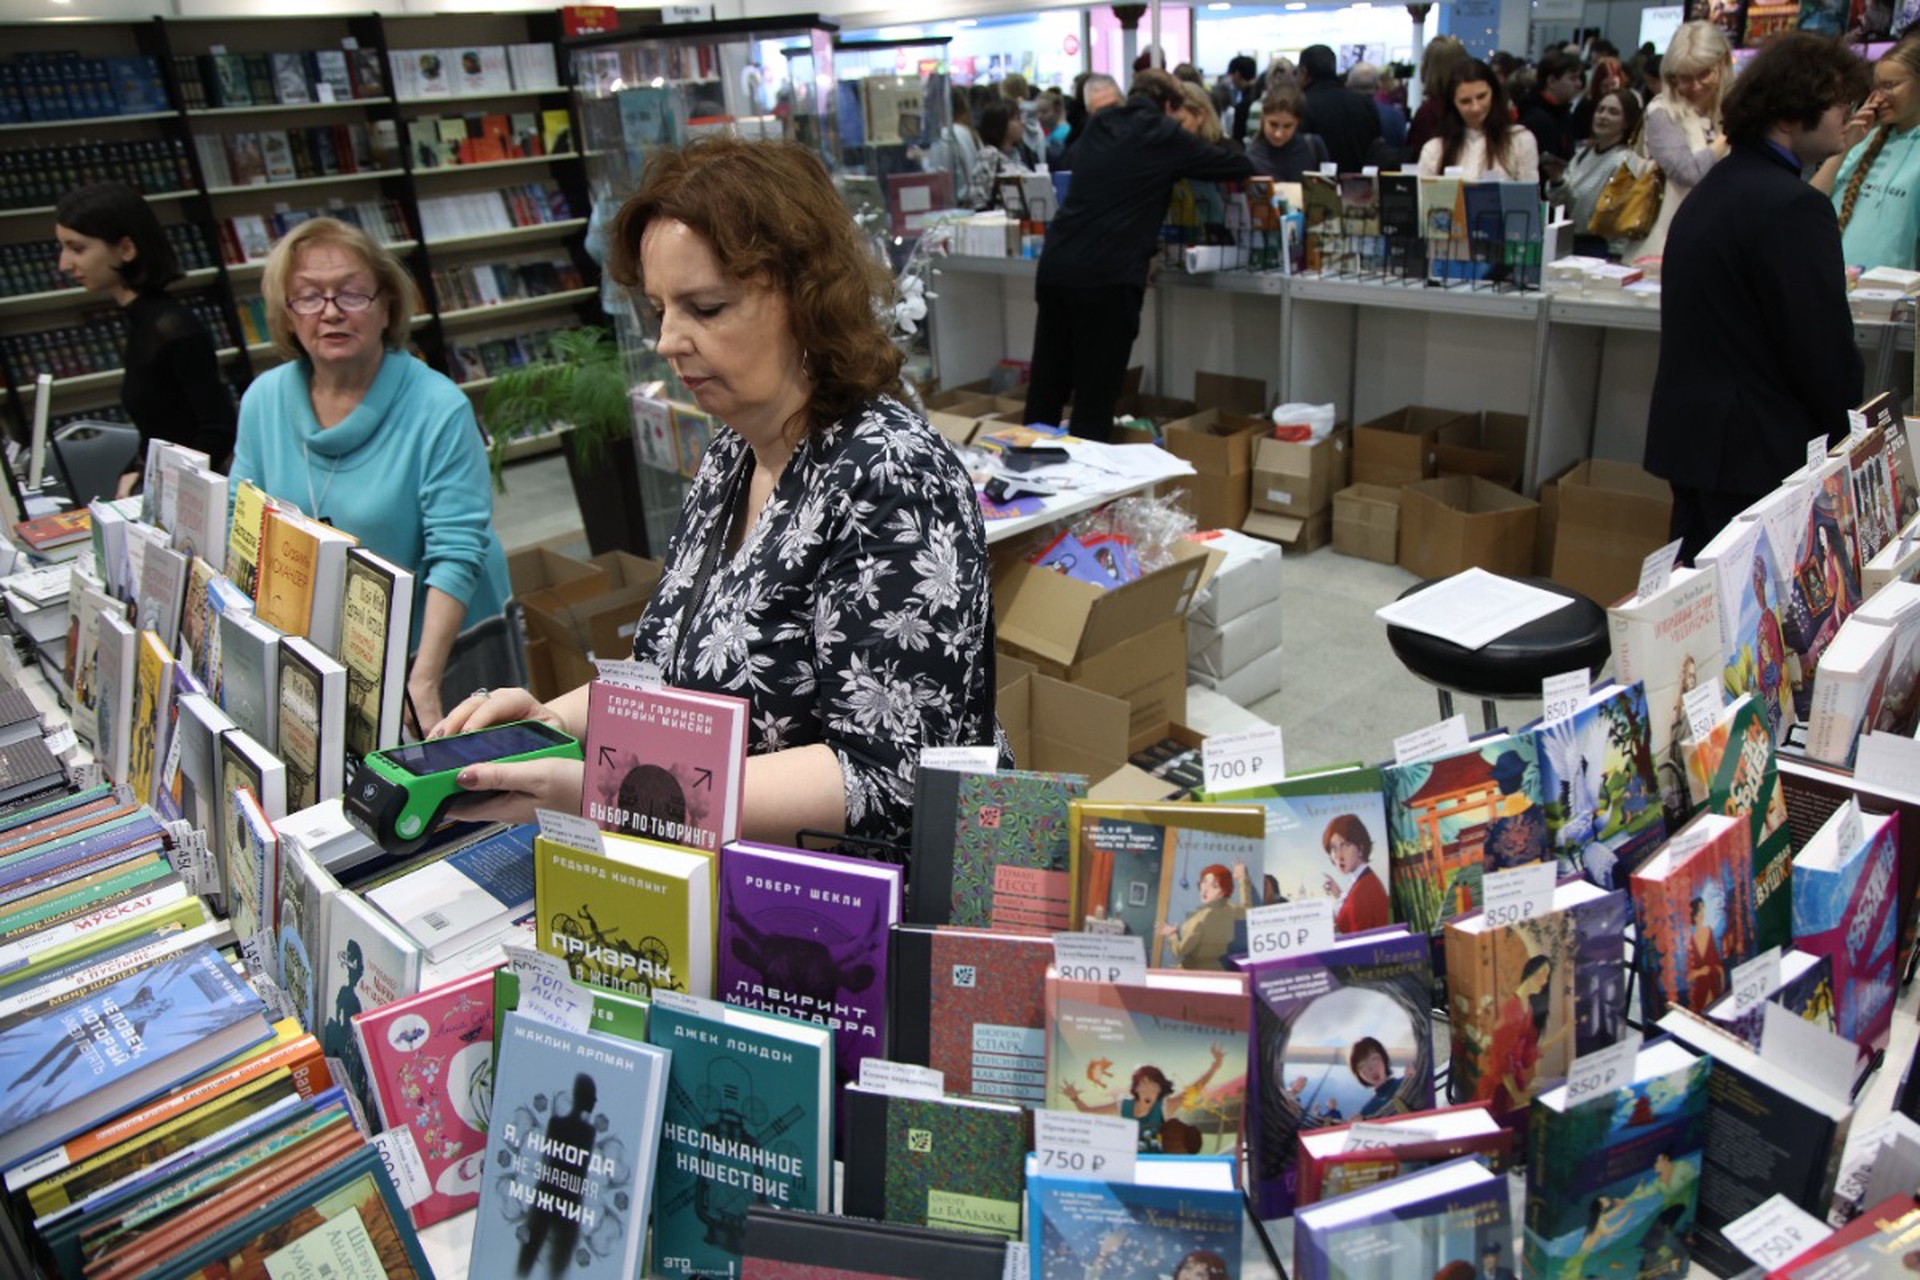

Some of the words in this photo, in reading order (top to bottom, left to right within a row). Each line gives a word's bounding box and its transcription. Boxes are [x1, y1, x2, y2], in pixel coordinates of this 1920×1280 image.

[607, 706, 656, 722] МАРВИН
[661, 716, 713, 735] МИНСКИ
[608, 695, 644, 710] ГАРРИ
[650, 704, 713, 724] ГАРРИСОН
[1208, 759, 1246, 781] 700
[590, 802, 630, 828] ВЫБОР
[632, 812, 648, 832] ПО
[651, 817, 716, 849] ТЬЮРИНГУ
[552, 855, 607, 881] РЕДЬЯРД
[612, 872, 668, 895] КИПЛИНГ
[745, 875, 803, 896] РОБЕРТ
[810, 888, 862, 908] ШЕКЛИ
[998, 879, 1038, 893] ГЕССЕ
[1486, 905, 1519, 927] 850
[551, 932, 672, 984] ПРИЗРАК
[1253, 930, 1291, 953] 650
[575, 965, 584, 980] В
[1061, 965, 1101, 981] 800
[726, 993, 877, 1038] МИНОТАВРА
[736, 980, 868, 1020] ЛАБИРИНТ
[78, 1005, 130, 1067] КОТОРЫЙ
[514, 1027, 572, 1052] ЖАКЛИН
[576, 1046, 635, 1071] АРПМАН
[674, 1025, 718, 1046] ДЖЕК
[727, 1038, 793, 1063] ЛОНДОН
[975, 1039, 1023, 1053] СПАРК
[1568, 1074, 1599, 1100] 850
[503, 1122, 520, 1147] Я,
[527, 1132, 616, 1178] НИКОГДА
[663, 1122, 803, 1178] НЕСЛЫХАННОЕ
[1042, 1149, 1085, 1171] 750
[510, 1157, 530, 1176] НЕ
[533, 1158, 600, 1200] ЗНАВШАЯ
[676, 1152, 790, 1202] НАШЕСТВИЕ
[508, 1181, 596, 1228] МУЖЧИН
[944, 1206, 1009, 1226] БАЛЬЗАК
